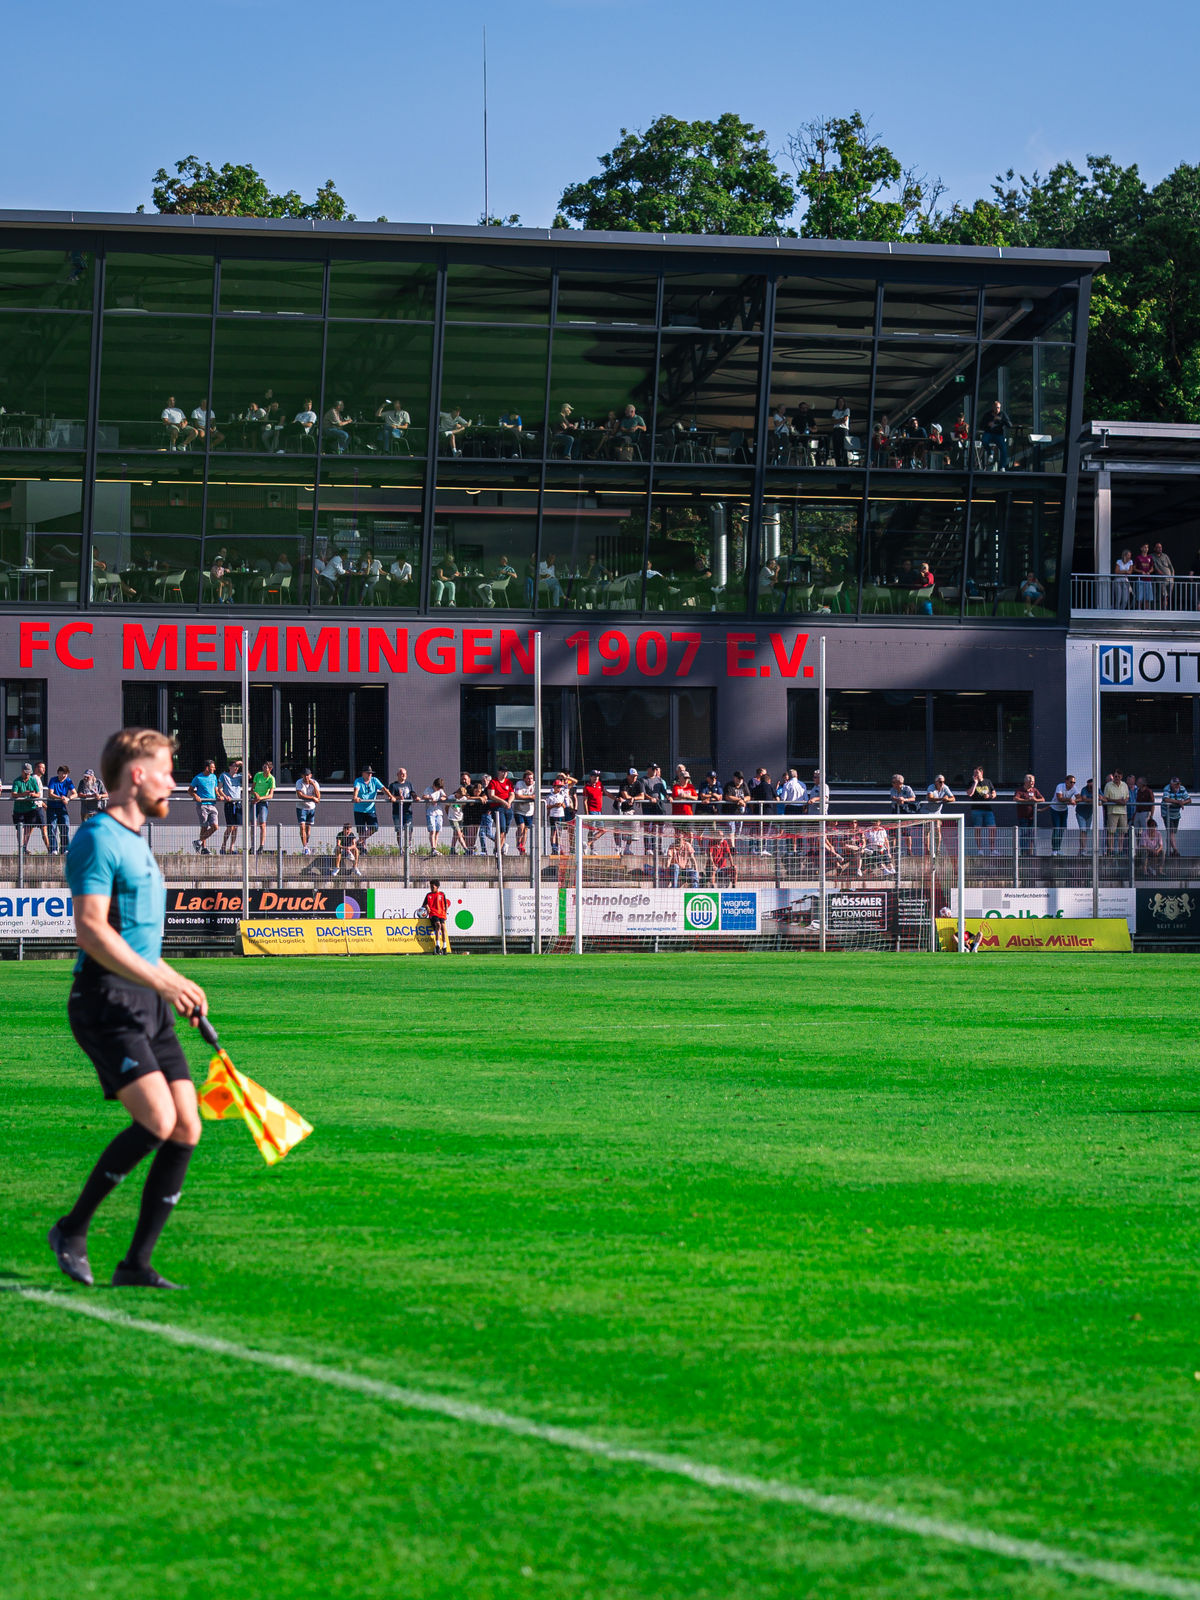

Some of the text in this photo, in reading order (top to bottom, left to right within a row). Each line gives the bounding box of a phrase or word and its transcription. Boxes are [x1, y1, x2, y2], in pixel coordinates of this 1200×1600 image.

[19, 621, 815, 678] FC MEMMINGEN 1907 E.V.
[258, 892, 328, 911] Druck
[723, 900, 751, 908] wagner
[831, 895, 882, 906] MÖSSMER
[602, 911, 677, 923] die anzieht
[722, 907, 755, 916] magnete
[831, 910, 882, 918] AUTOMOBILE
[247, 927, 304, 938] DACHSER
[316, 926, 373, 937] DACHSER
[1005, 935, 1044, 948] Alois
[1045, 935, 1095, 947] Müller
